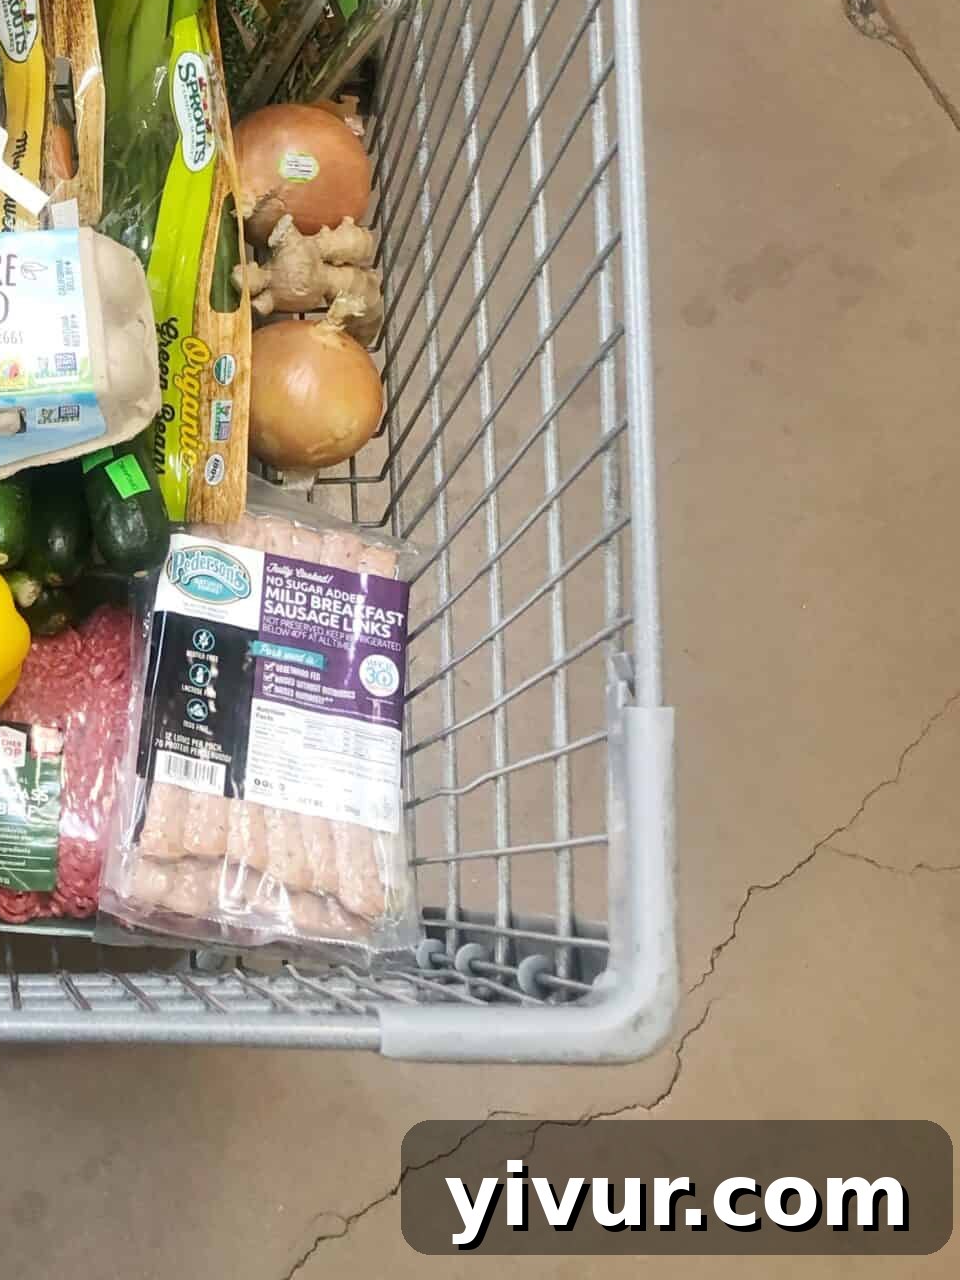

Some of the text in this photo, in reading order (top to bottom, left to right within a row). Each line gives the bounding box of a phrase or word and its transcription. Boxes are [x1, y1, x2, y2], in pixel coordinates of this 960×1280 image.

[178, 62, 206, 164] SPROUTS
[155, 316, 179, 391] Green
[175, 336, 212, 472] Organic
[265, 586, 404, 626] MILD BREAKFAST
[266, 576, 283, 587] NO
[285, 579, 323, 595] SUGAR
[264, 600, 340, 629] SAUSAGE
